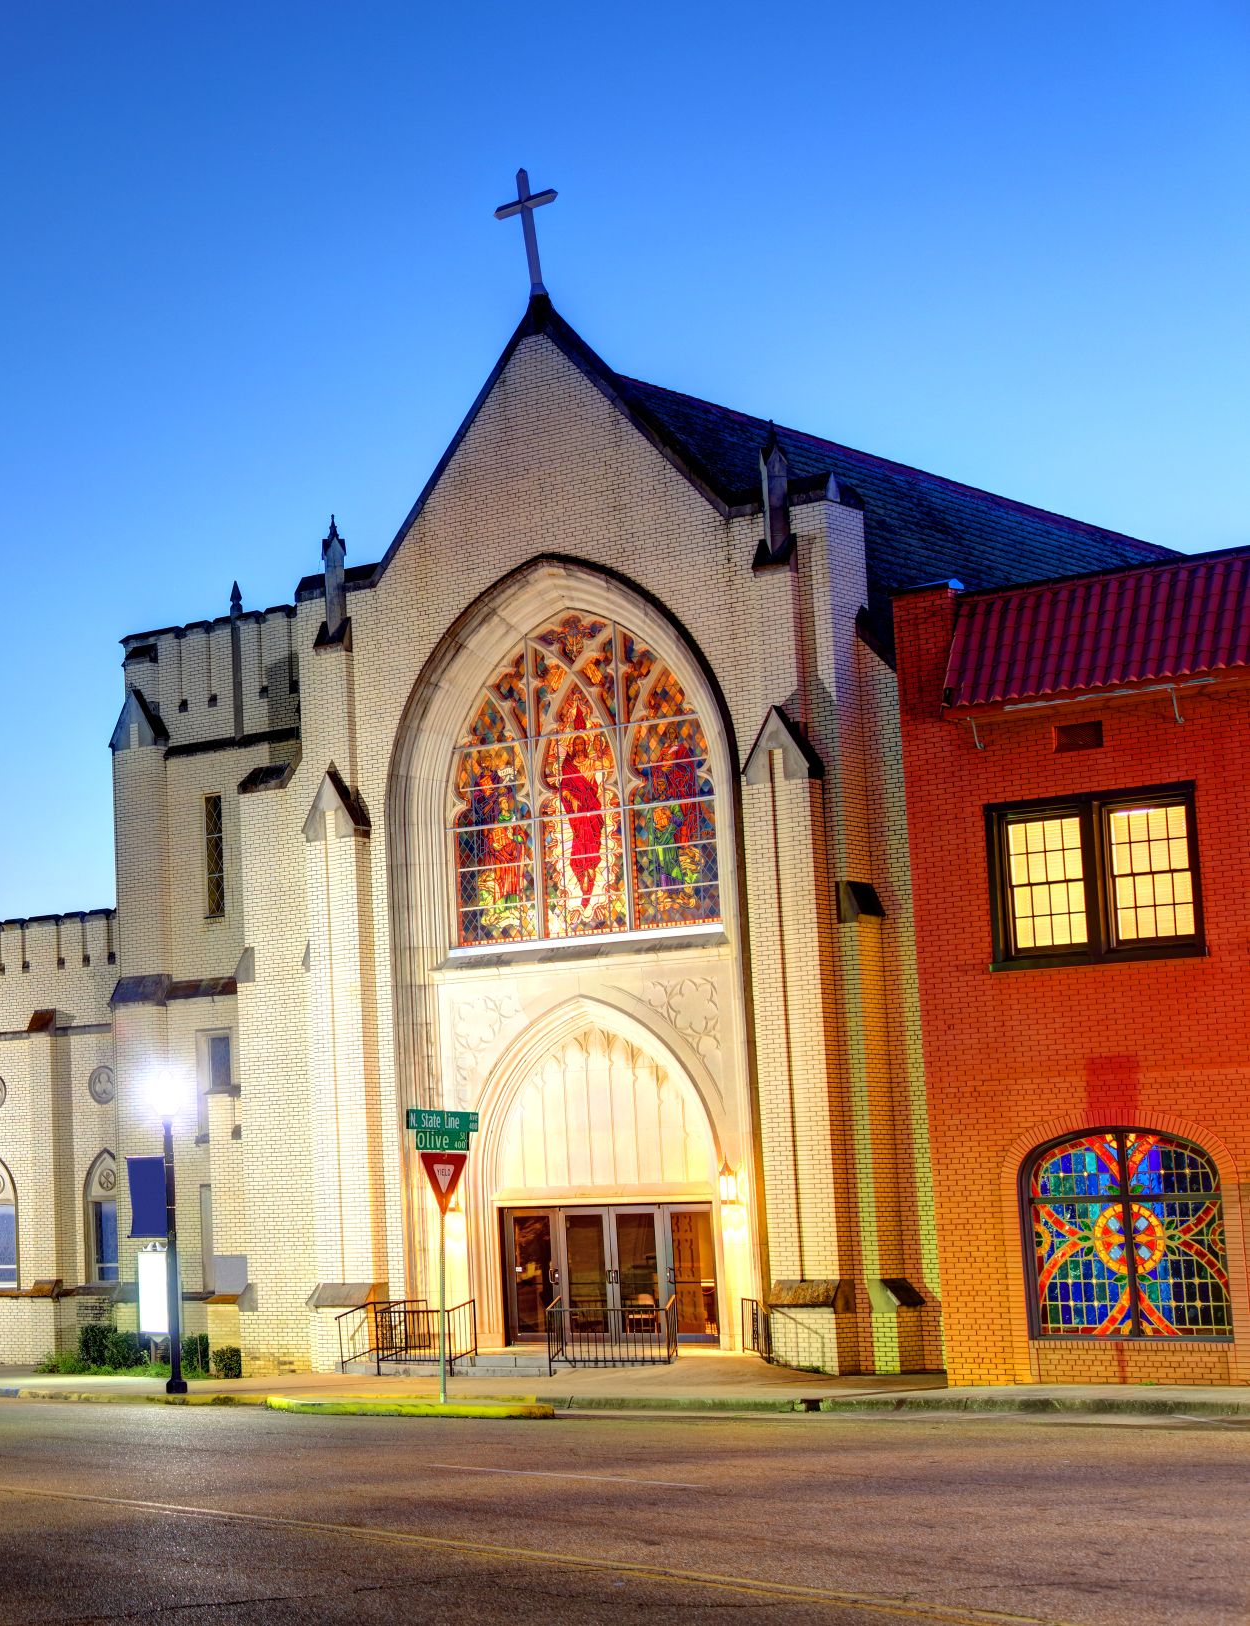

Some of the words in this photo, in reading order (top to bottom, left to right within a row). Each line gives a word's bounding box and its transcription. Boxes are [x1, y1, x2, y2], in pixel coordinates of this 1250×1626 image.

[410, 1113, 418, 1127] N.
[421, 1113, 441, 1128] State
[445, 1112, 459, 1129] Line
[417, 1132, 449, 1148] Olive
[454, 1141, 466, 1149] 400
[437, 1168, 451, 1176] YIELD
